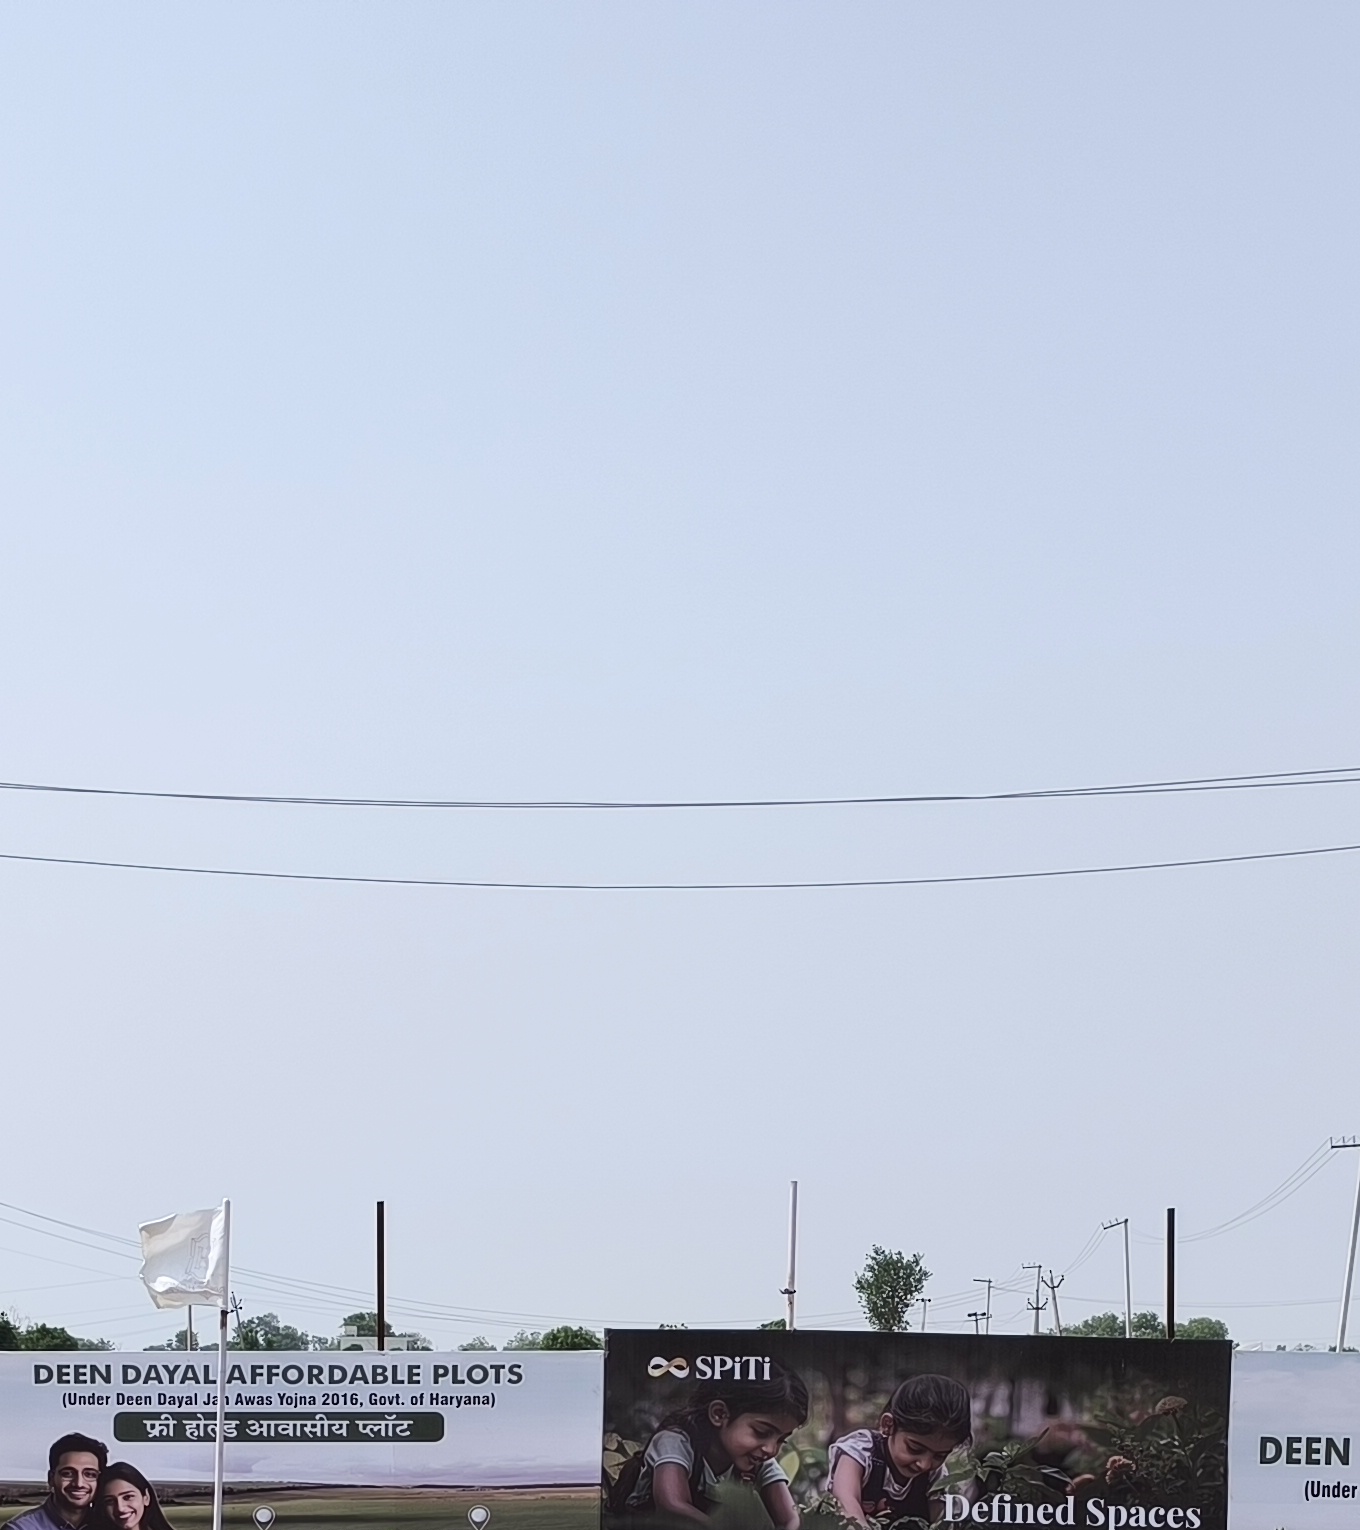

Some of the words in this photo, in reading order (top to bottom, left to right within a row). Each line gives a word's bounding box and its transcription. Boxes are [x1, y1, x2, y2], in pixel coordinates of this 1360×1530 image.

[33, 1364, 112, 1385] DEEN
[121, 1364, 217, 1385] DAYAL
[226, 1364, 421, 1385] AFFORDABLE
[433, 1363, 524, 1385] PLOTS
[62, 1392, 111, 1408] (Under
[116, 1392, 152, 1405] Deen
[157, 1392, 198, 1409] Dayal
[235, 1393, 273, 1406] Awas
[278, 1392, 317, 1408] Yojna
[321, 1392, 363, 1408] 2016,
[368, 1392, 405, 1406] Govt.
[410, 1393, 424, 1405] of
[430, 1392, 496, 1408] Haryana)
[143, 1414, 177, 1438] फ्री
[246, 1414, 349, 1438] आवासीय
[355, 1413, 414, 1438] प्लॉट
[1259, 1436, 1351, 1466] DEEN
[1304, 1480, 1358, 1502] (Under
[942, 1493, 1076, 1525] Defined
